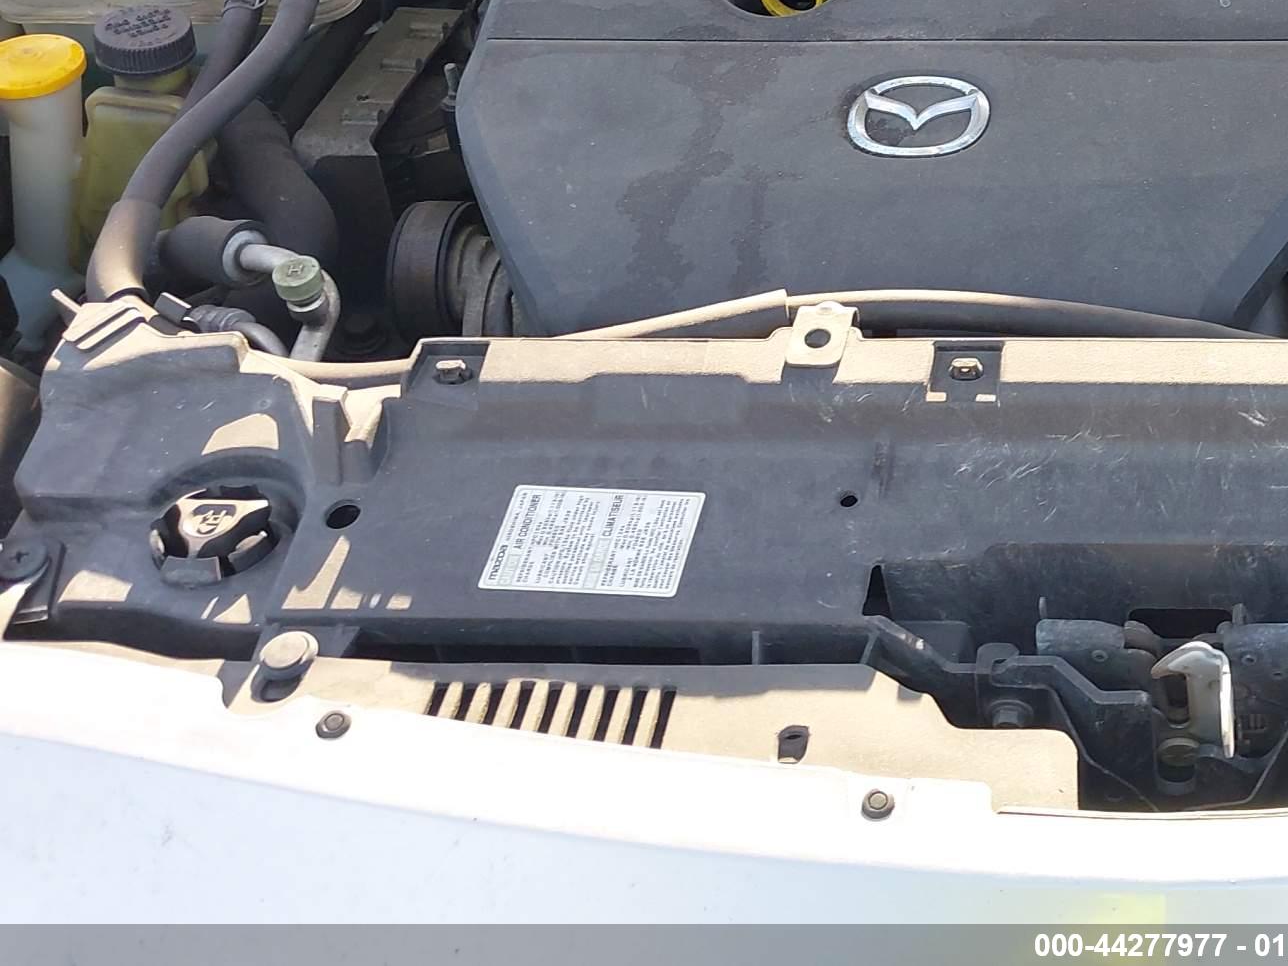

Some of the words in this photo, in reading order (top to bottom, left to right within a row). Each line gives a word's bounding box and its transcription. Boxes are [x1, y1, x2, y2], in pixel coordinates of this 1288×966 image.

[517, 494, 541, 537] CONDITIONER
[601, 494, 624, 536] CLIMATISEUR
[488, 544, 508, 579] mazda
[512, 538, 526, 549] AIR
